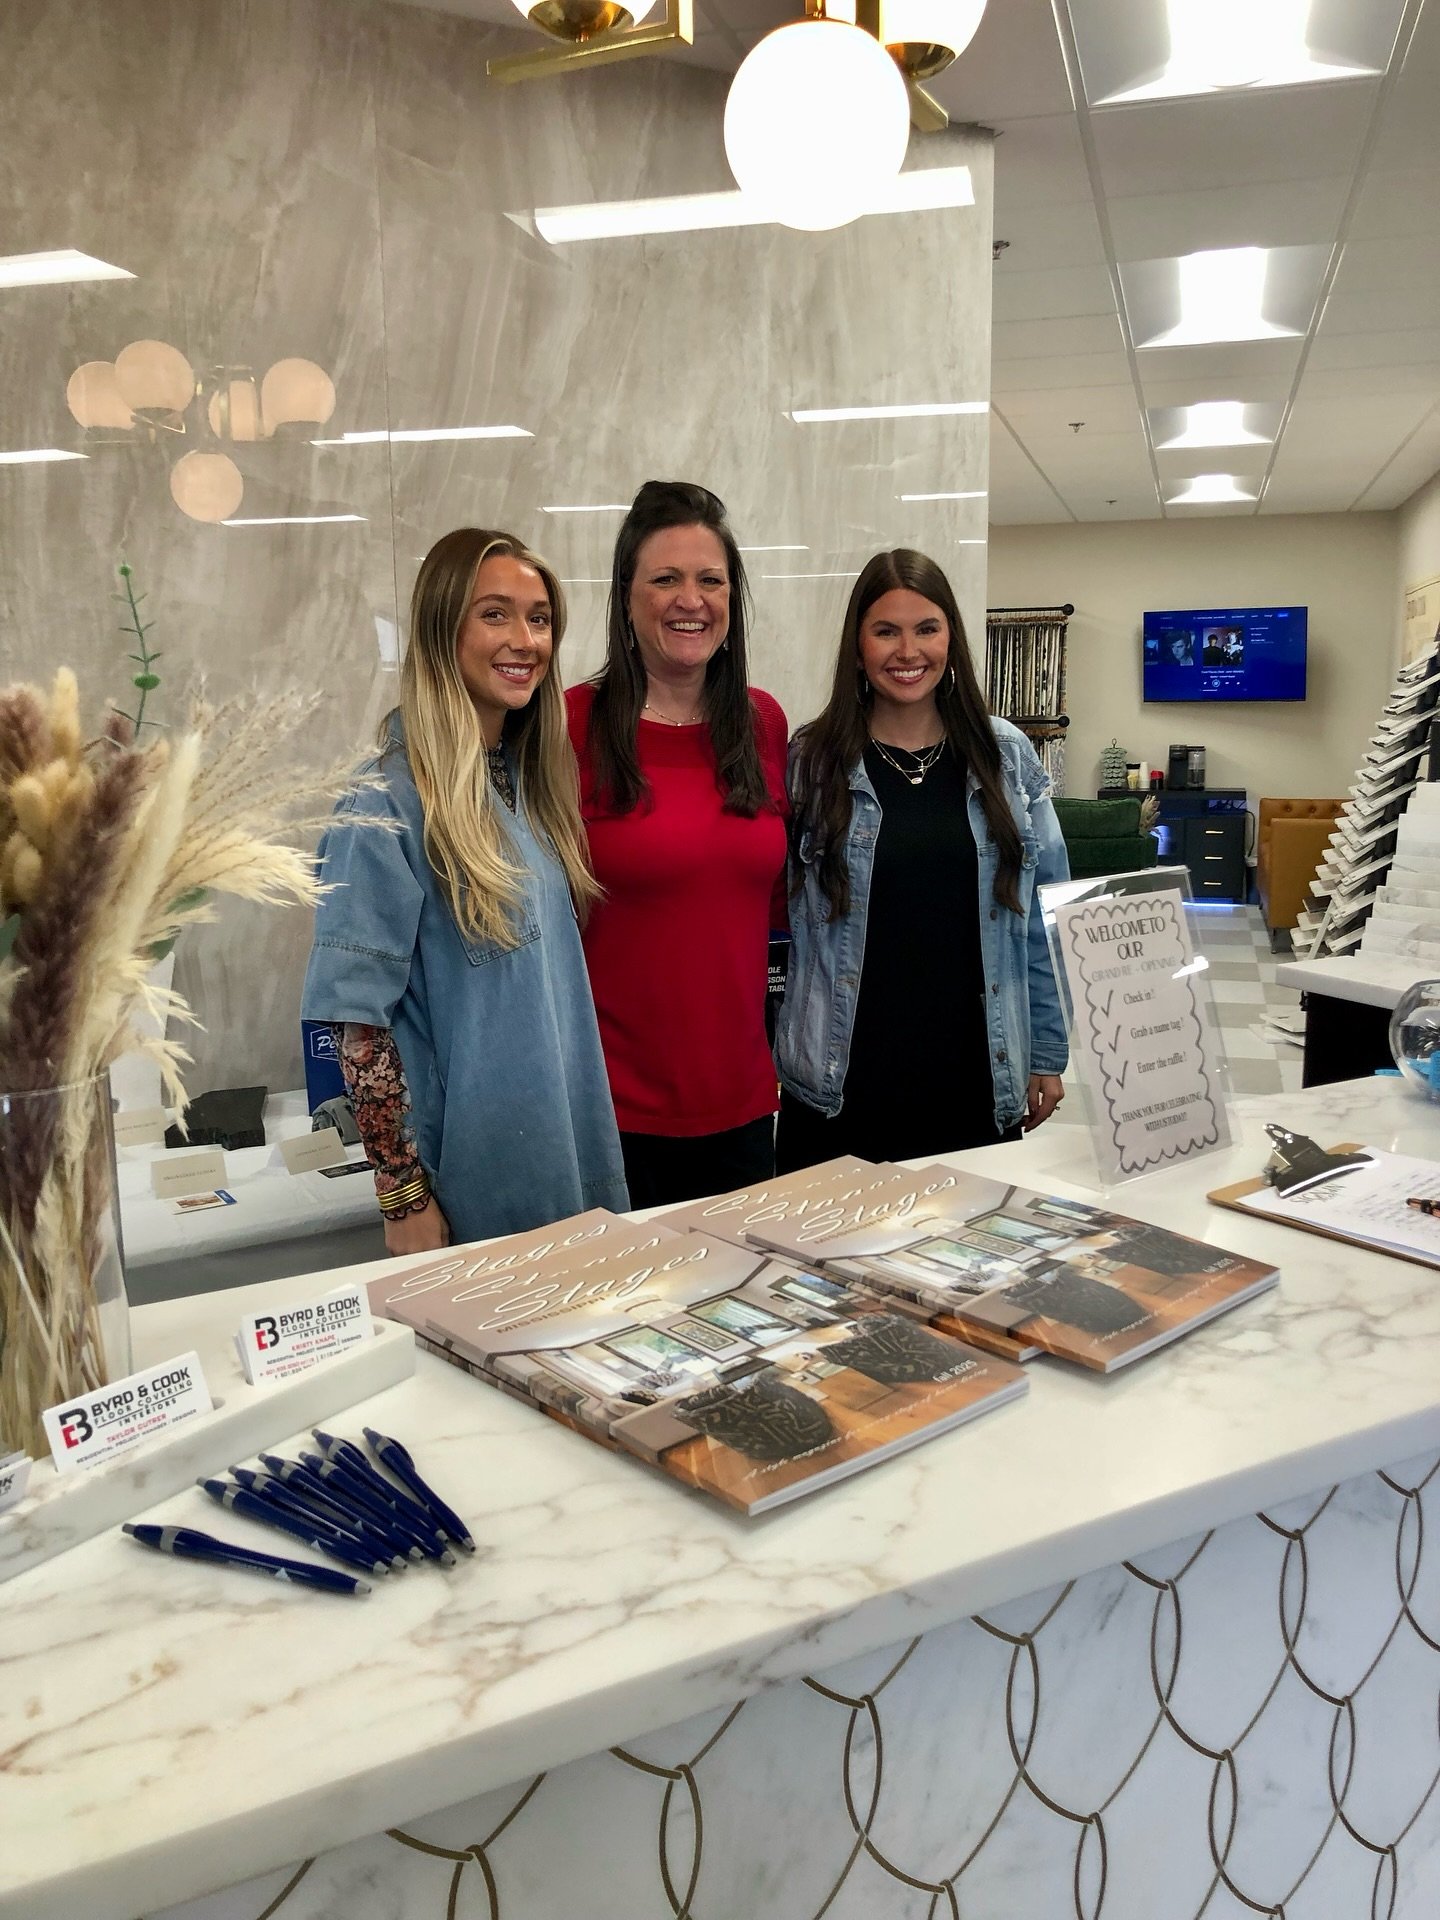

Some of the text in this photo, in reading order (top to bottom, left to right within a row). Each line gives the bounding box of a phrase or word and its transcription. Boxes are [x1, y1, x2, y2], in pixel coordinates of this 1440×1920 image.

[1117, 941, 1144, 960] OUR
[1123, 990, 1144, 1005] Check
[1130, 1026, 1148, 1039] Grab
[1137, 1060, 1156, 1074] Enter
[796, 1176, 957, 1242] Stages
[385, 1223, 609, 1303] Stages
[478, 1247, 709, 1331] Stages
[280, 1296, 360, 1327] BYRD & COOK
[281, 1307, 361, 1335] FLOOR COVERING
[496, 1293, 607, 1334] MISSISSIPPI
[299, 1321, 347, 1339] INTERIORS
[932, 1359, 978, 1383] fall 2025
[91, 1367, 191, 1417] BYRD & COOK
[94, 1380, 193, 1426] FLOOR COVERING
[118, 1398, 177, 1427] INTERIORS
[106, 1426, 136, 1444] TAYLOR
